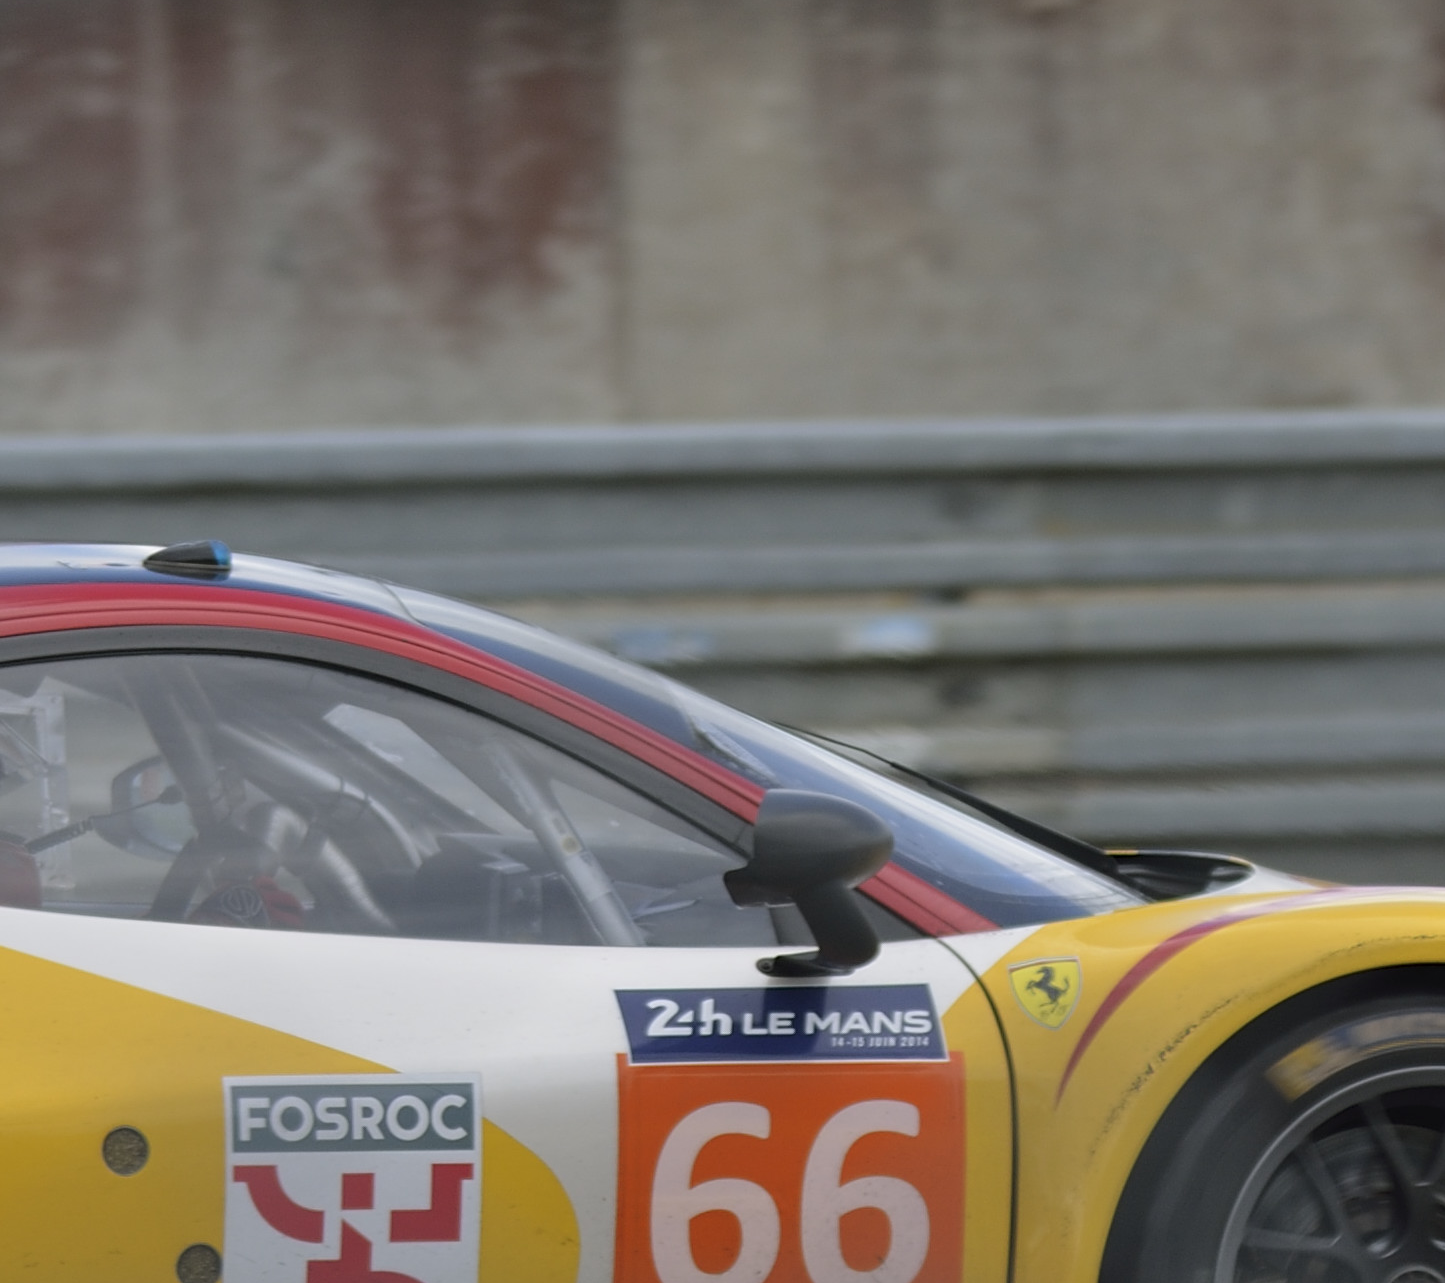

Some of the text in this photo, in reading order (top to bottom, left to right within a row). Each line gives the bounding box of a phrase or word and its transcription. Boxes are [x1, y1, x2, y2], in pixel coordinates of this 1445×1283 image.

[645, 999, 934, 1037] 24h LE MANS
[830, 1036, 930, 1047] 14-15 JUIN 2014
[237, 1094, 468, 1142] FOSROC
